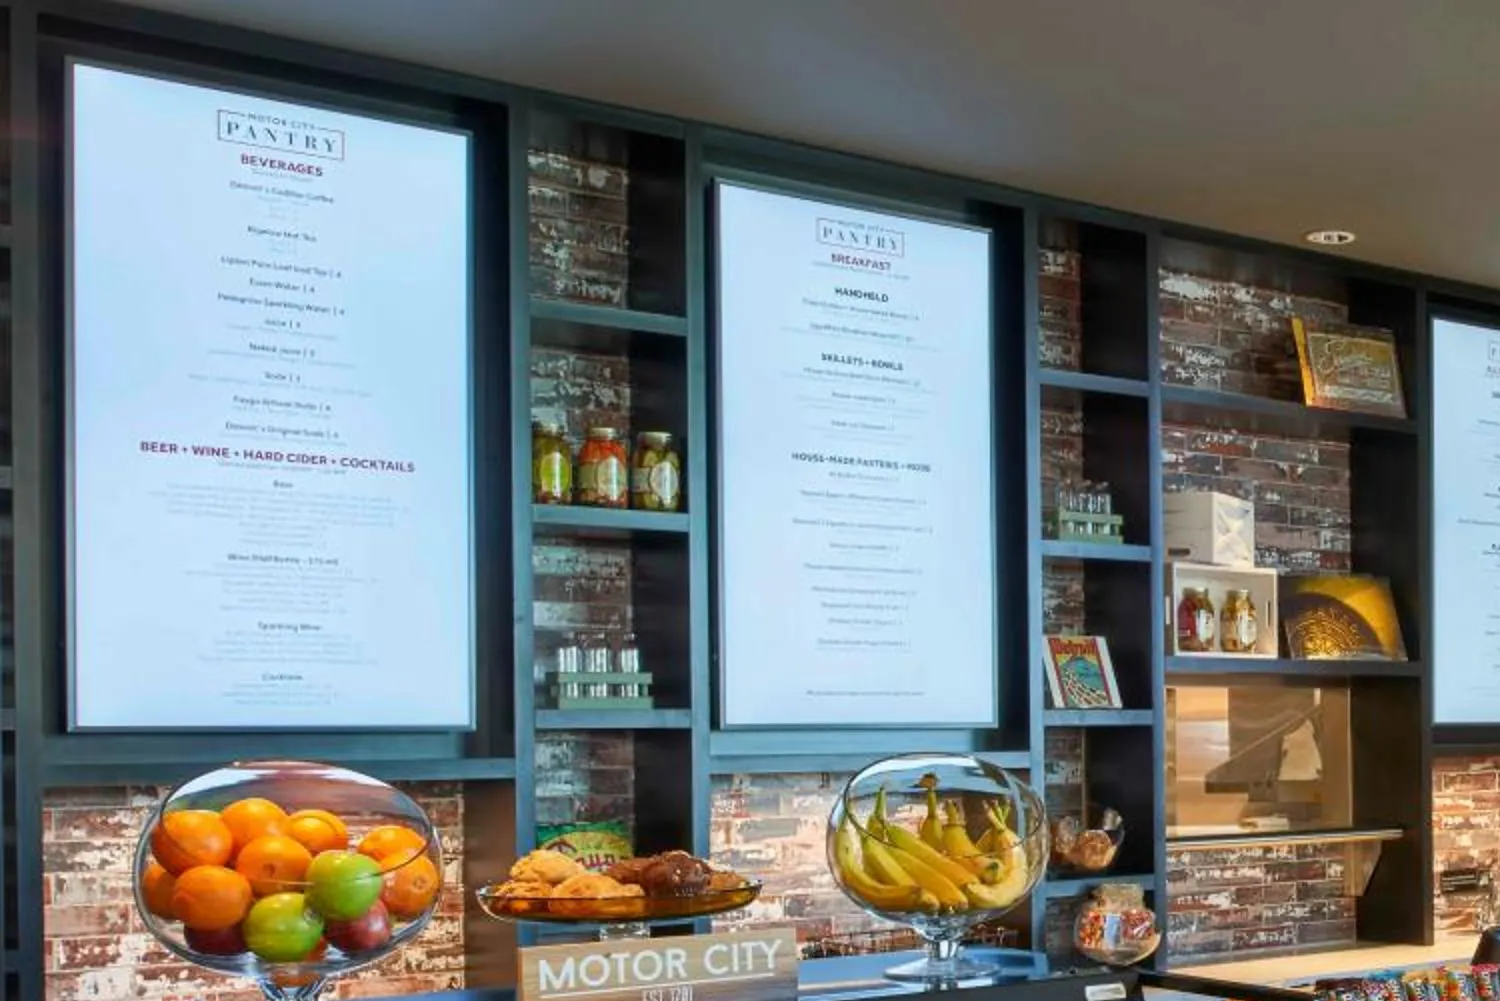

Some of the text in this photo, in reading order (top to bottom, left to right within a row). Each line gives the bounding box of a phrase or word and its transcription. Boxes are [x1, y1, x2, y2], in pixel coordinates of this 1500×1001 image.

[247, 112, 287, 127] MOTOR
[227, 120, 337, 153] PANTRY
[240, 152, 324, 177] BEVERAGES
[823, 226, 898, 250] PANTRY
[831, 252, 891, 271] BREAKFAST
[834, 286, 889, 303] HANDHELD
[821, 352, 864, 367] SKILLETS
[139, 439, 178, 455] BEER
[191, 443, 230, 460] WINE
[242, 448, 284, 464] HARD
[286, 452, 328, 467] CIDER
[340, 456, 416, 474] COCKTAILS
[538, 938, 783, 992] MOTOR CITY
